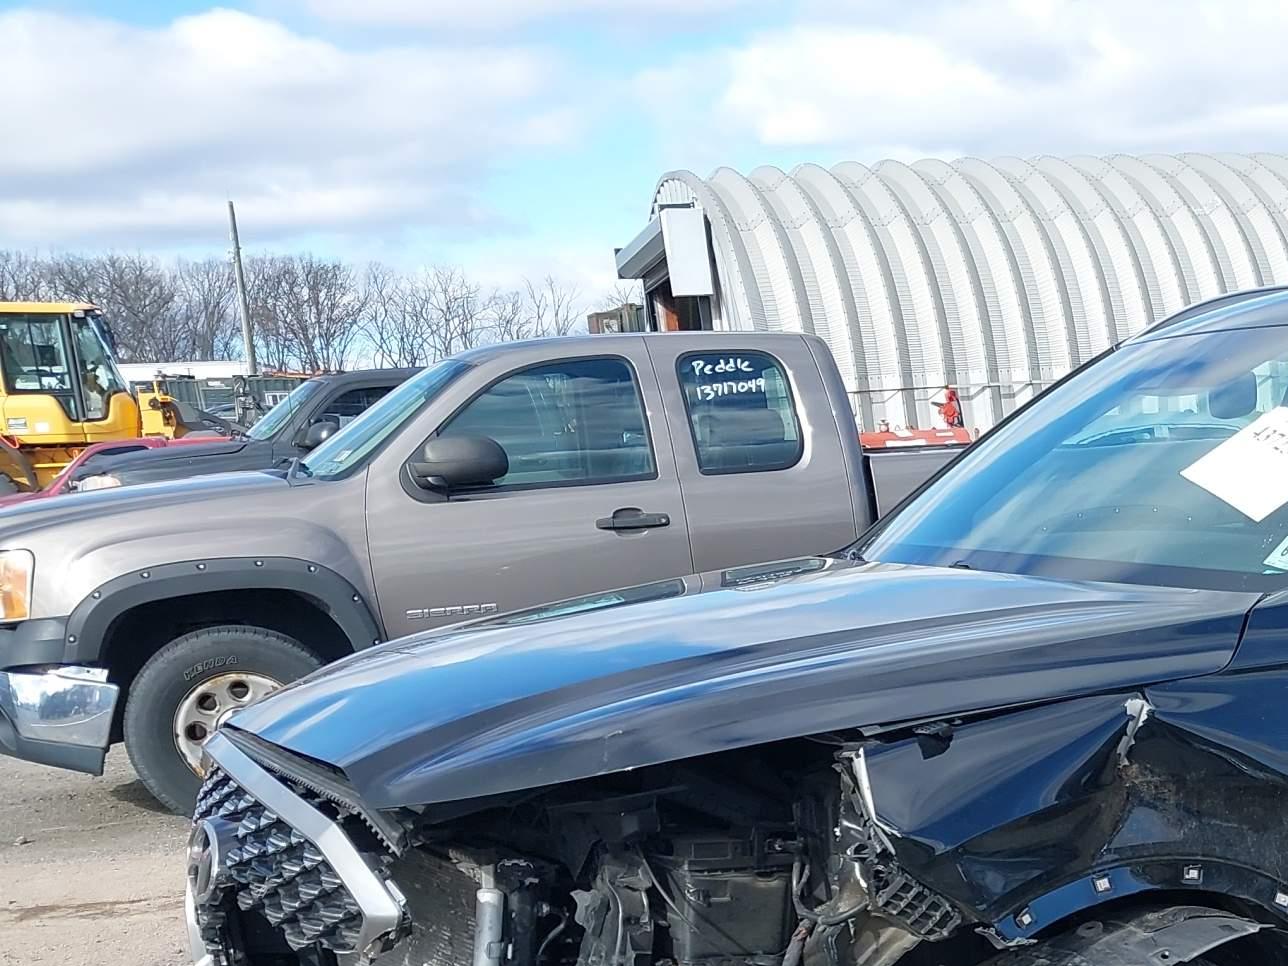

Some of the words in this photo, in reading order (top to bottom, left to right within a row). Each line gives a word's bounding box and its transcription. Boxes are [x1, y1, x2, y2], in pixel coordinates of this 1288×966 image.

[696, 377, 766, 401] 13717049
[406, 602, 498, 620] SIERRA
[183, 655, 239, 681] KENDA
